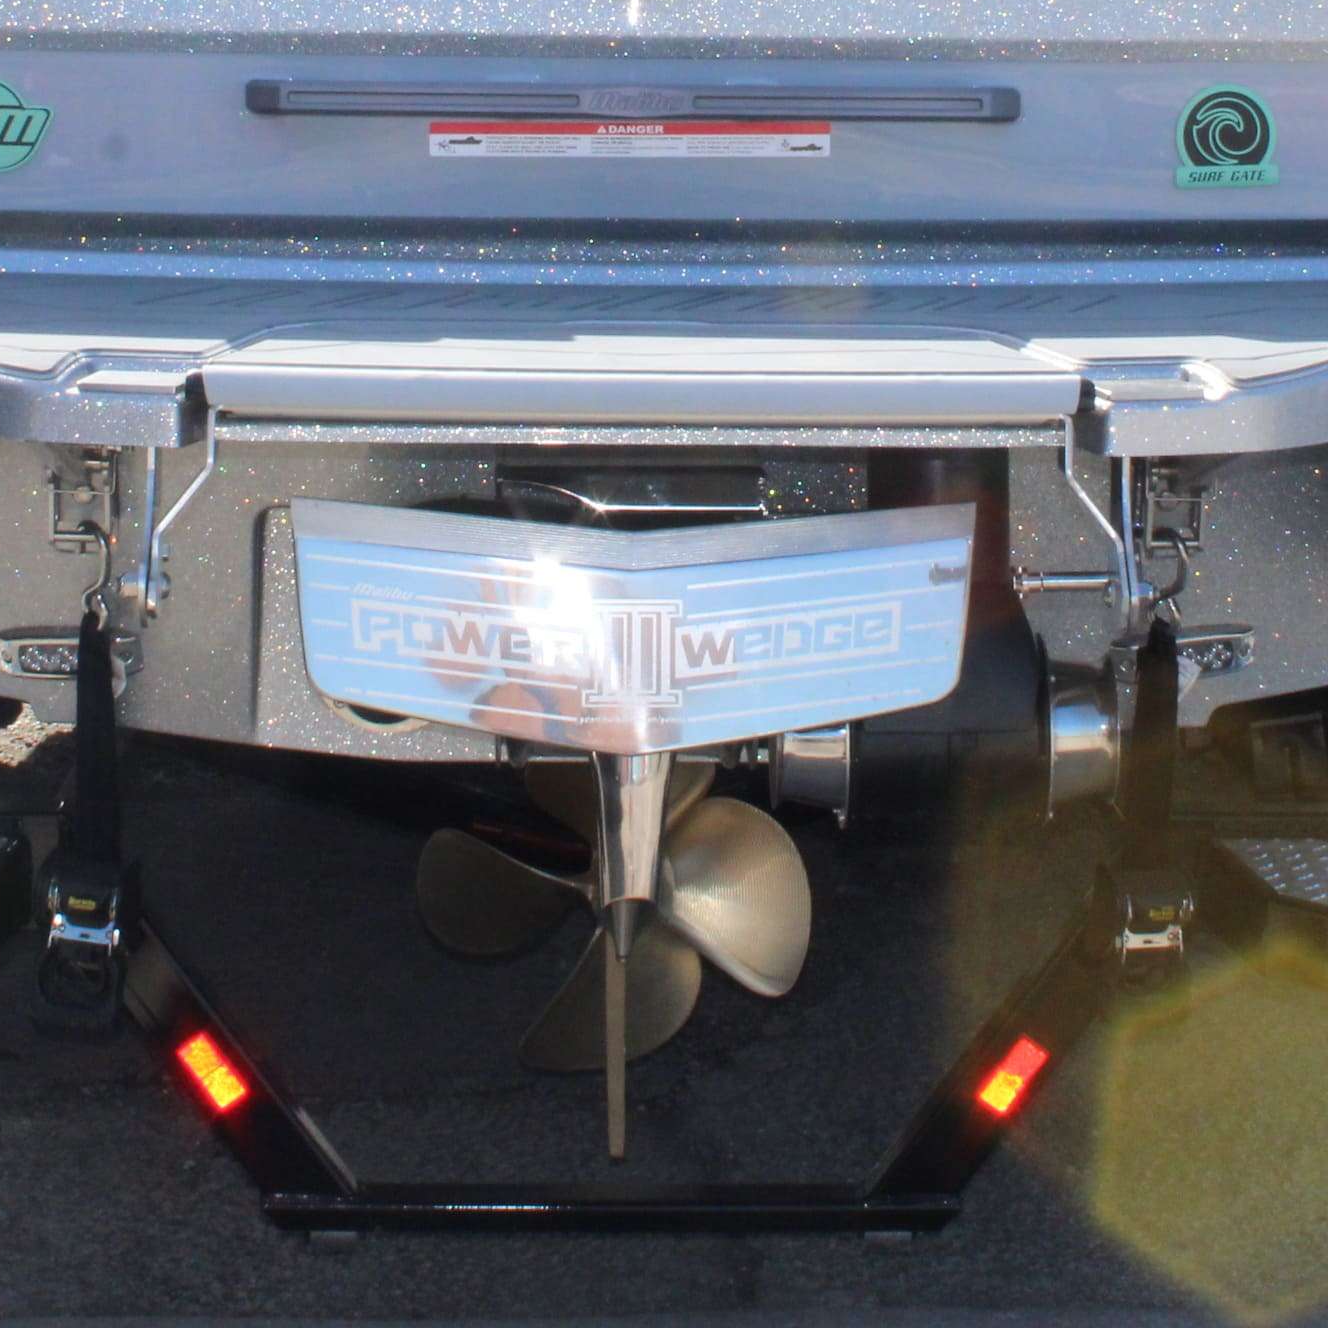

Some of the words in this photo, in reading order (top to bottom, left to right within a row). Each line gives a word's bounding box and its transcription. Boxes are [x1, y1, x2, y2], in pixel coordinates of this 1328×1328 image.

[608, 125, 664, 135] DANGER
[1188, 171, 1225, 183] SURF
[1231, 170, 1267, 182] GATE
